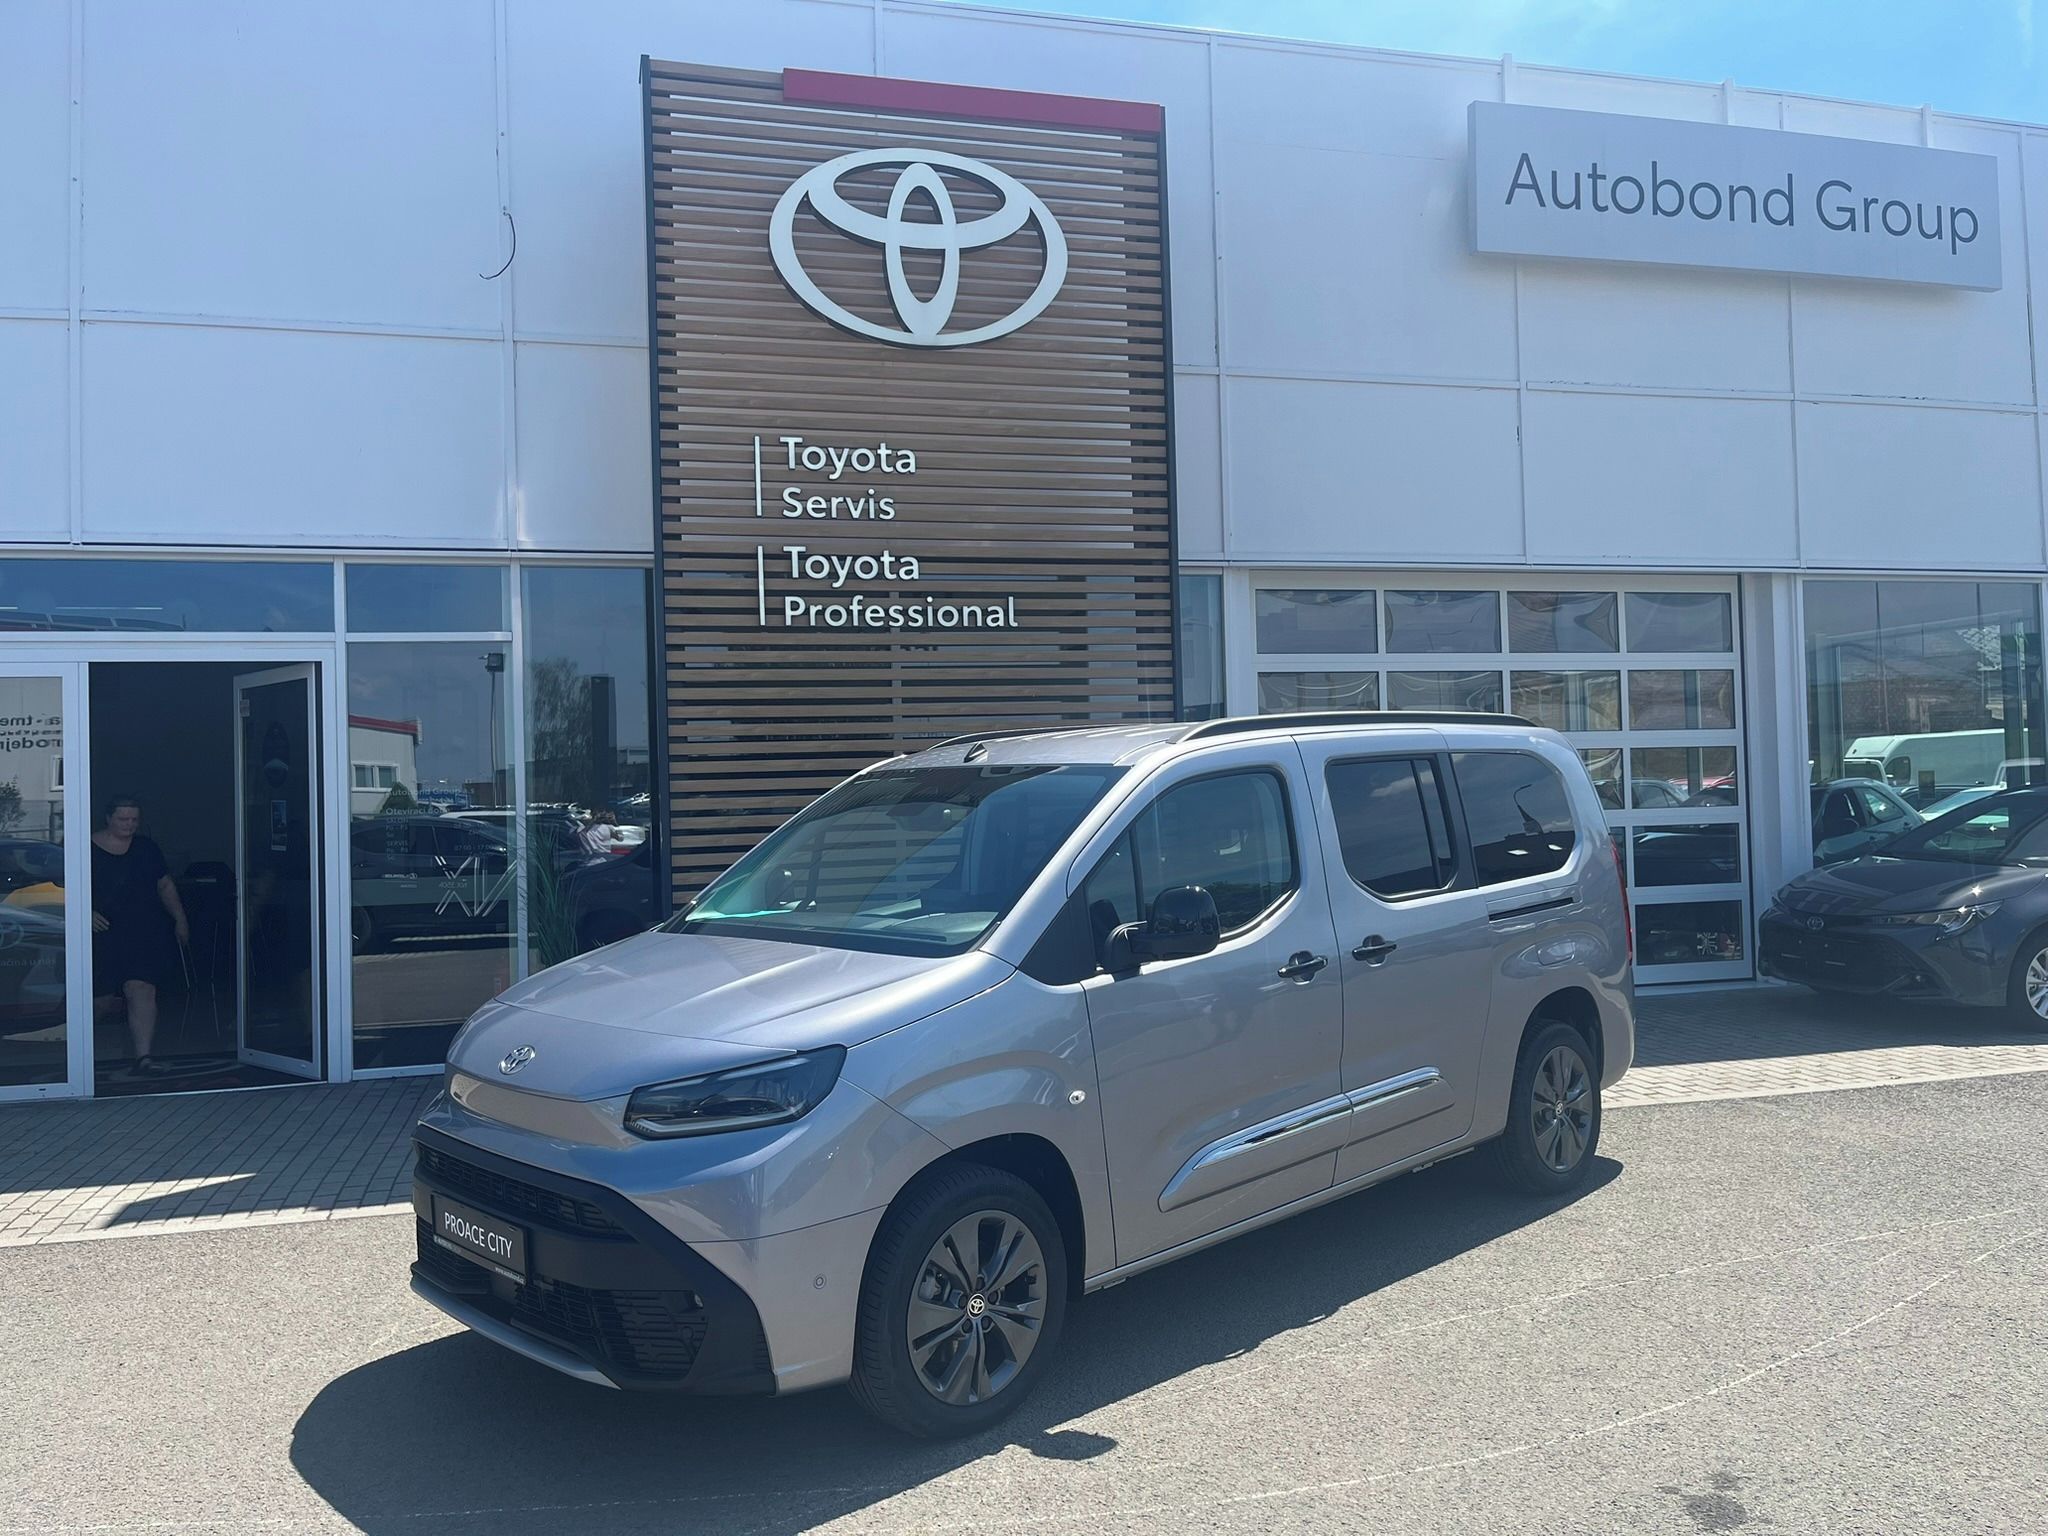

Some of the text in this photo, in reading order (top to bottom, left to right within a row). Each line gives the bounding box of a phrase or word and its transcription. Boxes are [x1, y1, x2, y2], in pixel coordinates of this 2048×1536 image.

[1504, 152, 1980, 255] Autobond Group
[779, 436, 917, 480] Toyota
[782, 487, 896, 520] Servis
[783, 545, 920, 588] Toyota
[784, 595, 1019, 628] Professional
[444, 1211, 486, 1248] PROACE
[487, 1232, 513, 1259] CITY
